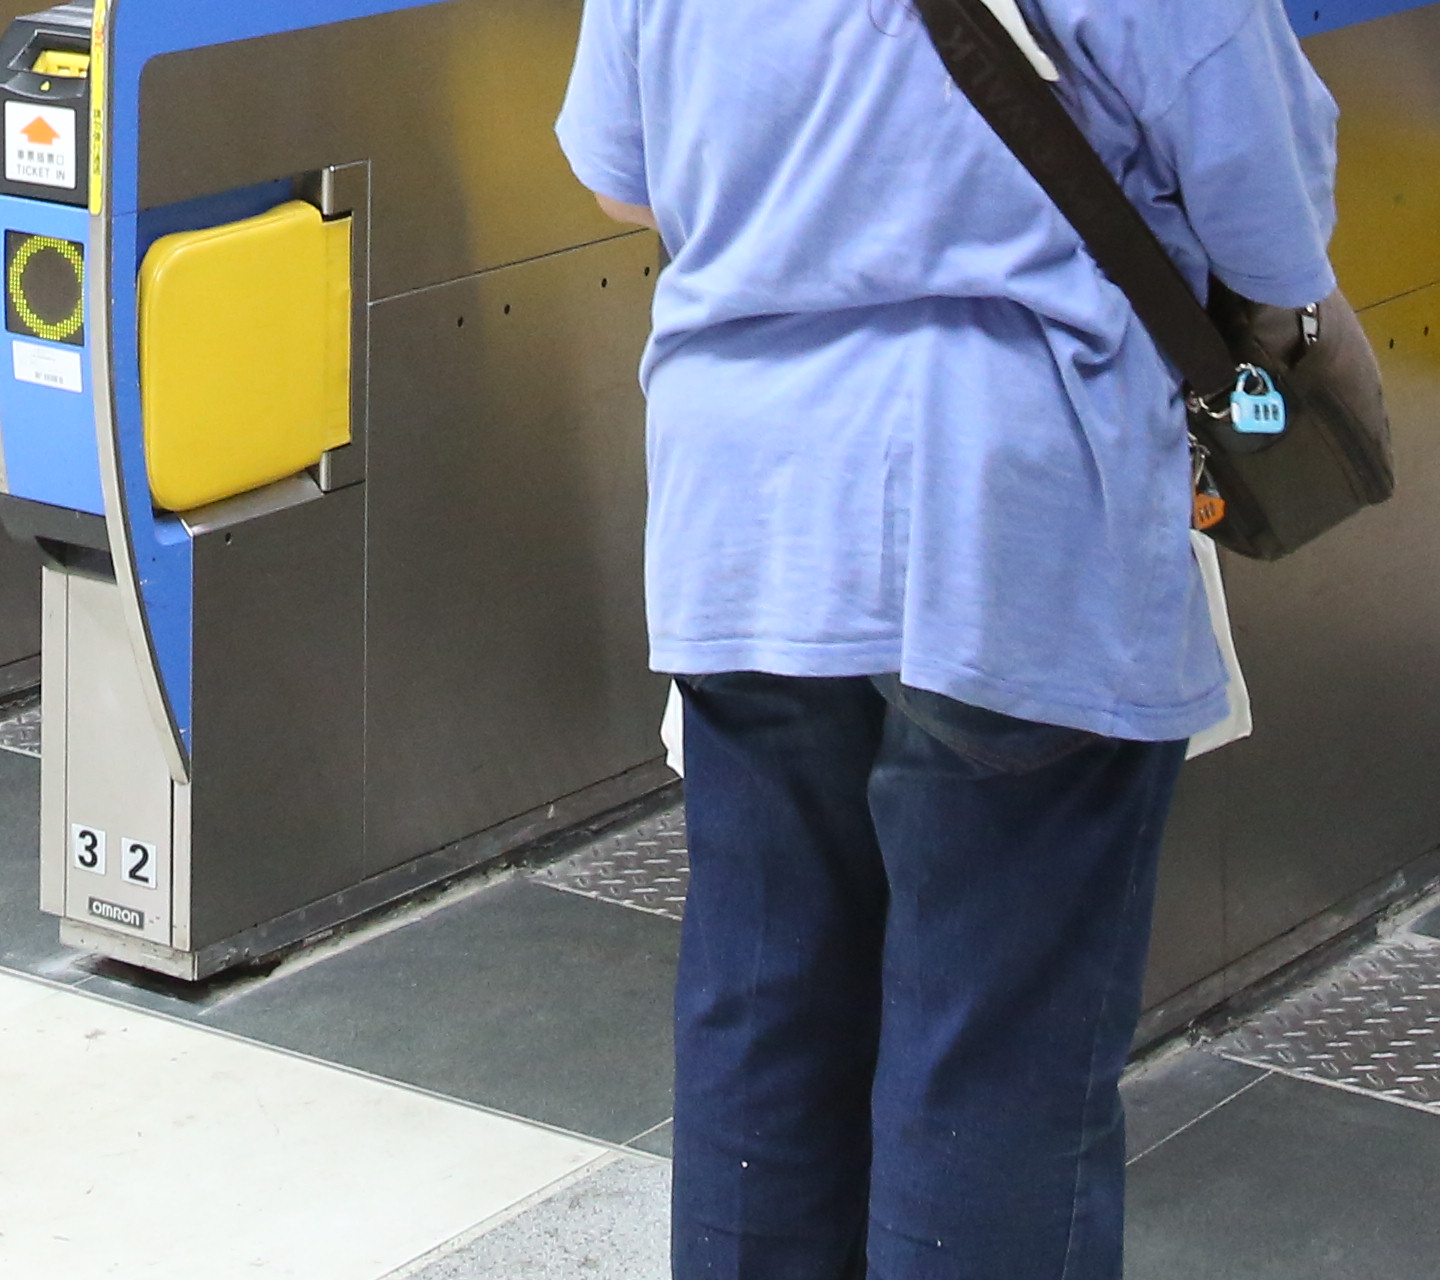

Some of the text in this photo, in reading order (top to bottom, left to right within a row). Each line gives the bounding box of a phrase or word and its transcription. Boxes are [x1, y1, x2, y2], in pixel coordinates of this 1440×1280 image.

[17, 163, 65, 181] TICKET IN
[79, 832, 150, 882] 3 2
[92, 901, 141, 925] OMRON
